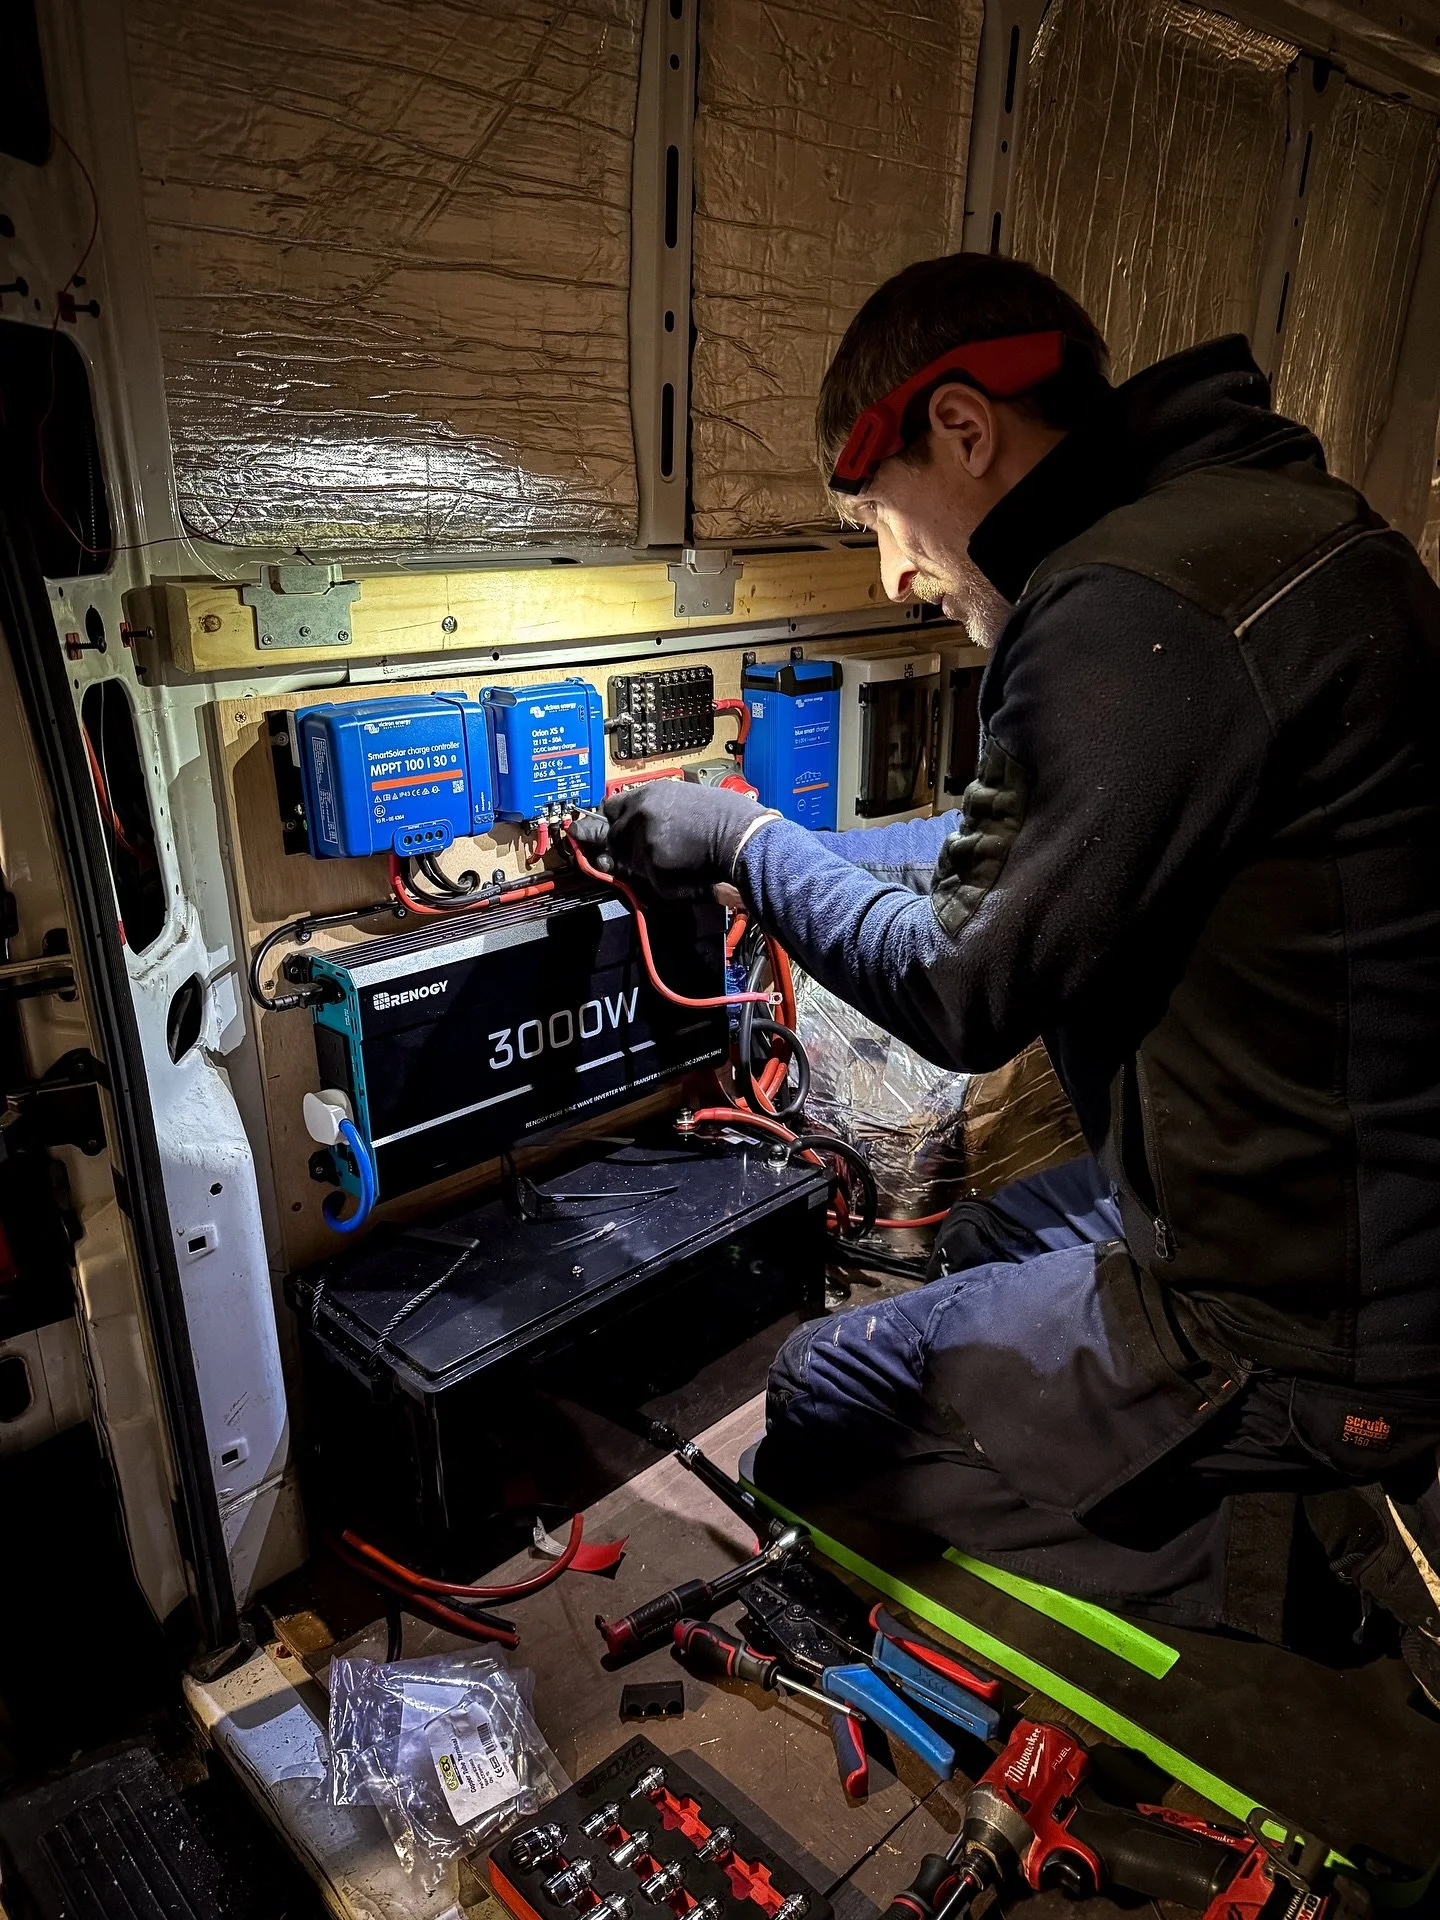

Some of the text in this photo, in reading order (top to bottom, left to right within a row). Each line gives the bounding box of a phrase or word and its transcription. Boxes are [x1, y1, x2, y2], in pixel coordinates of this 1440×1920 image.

[532, 729, 549, 737] Orion
[367, 740, 460, 761] SmartSolar charge controller
[370, 760, 403, 777] MPPT
[404, 757, 425, 772] 100
[433, 754, 448, 768] 30
[533, 770, 548, 779] IP65
[390, 980, 449, 1007] RENOGY
[488, 986, 639, 1070] 3000W
[577, 1097, 593, 1108] WAVE
[593, 1088, 619, 1102] INVERTER
[633, 1072, 658, 1087] TRANSFER
[1004, 1727, 1041, 1783] Milwaukee
[1052, 1747, 1072, 1770] FUEL
